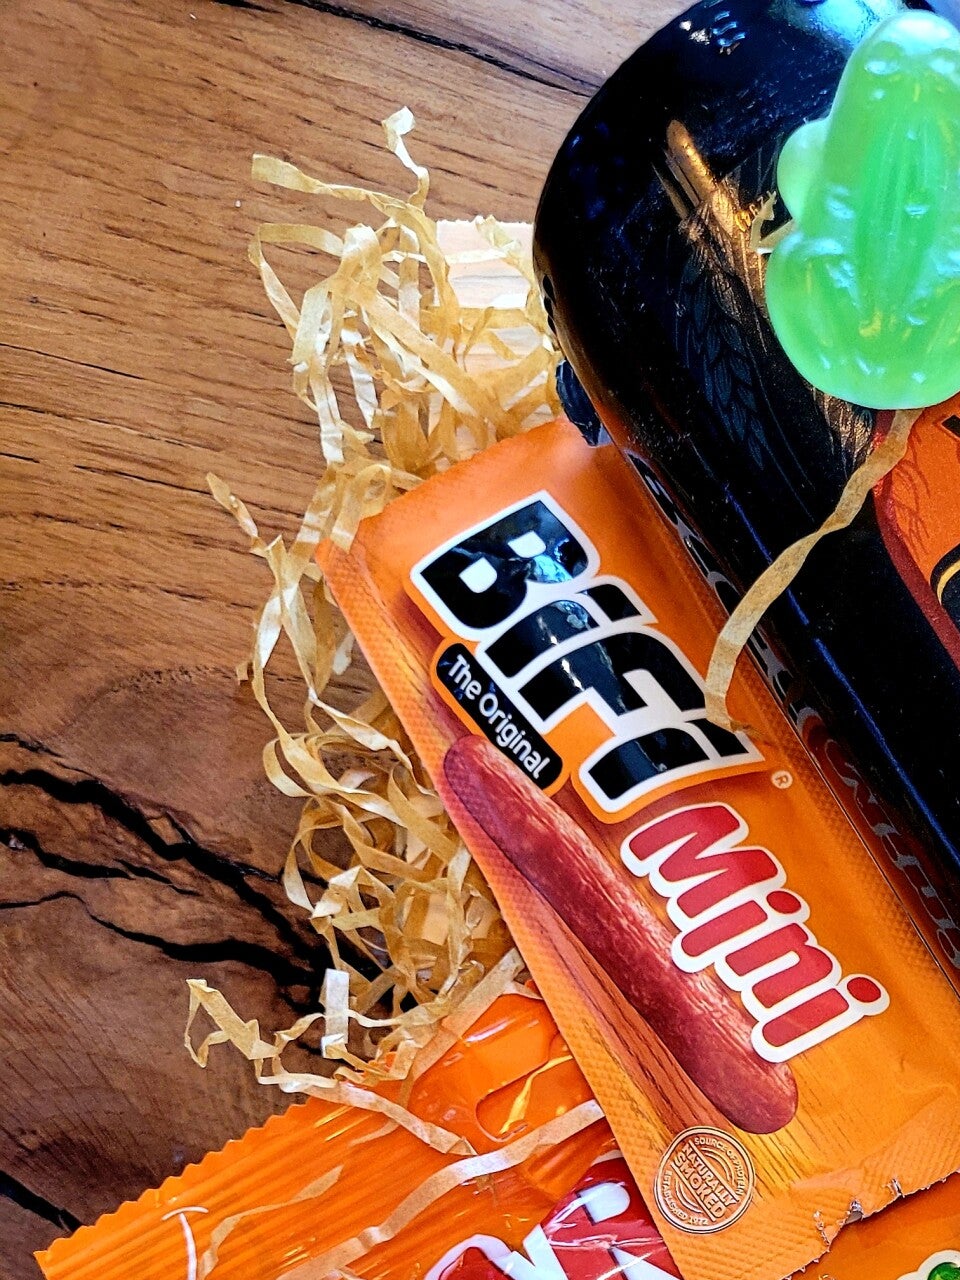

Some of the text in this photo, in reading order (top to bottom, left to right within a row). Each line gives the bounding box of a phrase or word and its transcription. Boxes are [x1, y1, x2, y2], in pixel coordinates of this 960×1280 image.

[412, 491, 764, 812] BiFi
[448, 654, 550, 779] The Original
[623, 803, 888, 1060] Mini
[674, 1151, 728, 1218] SMOKED
[682, 1143, 737, 1207] NATURALLY
